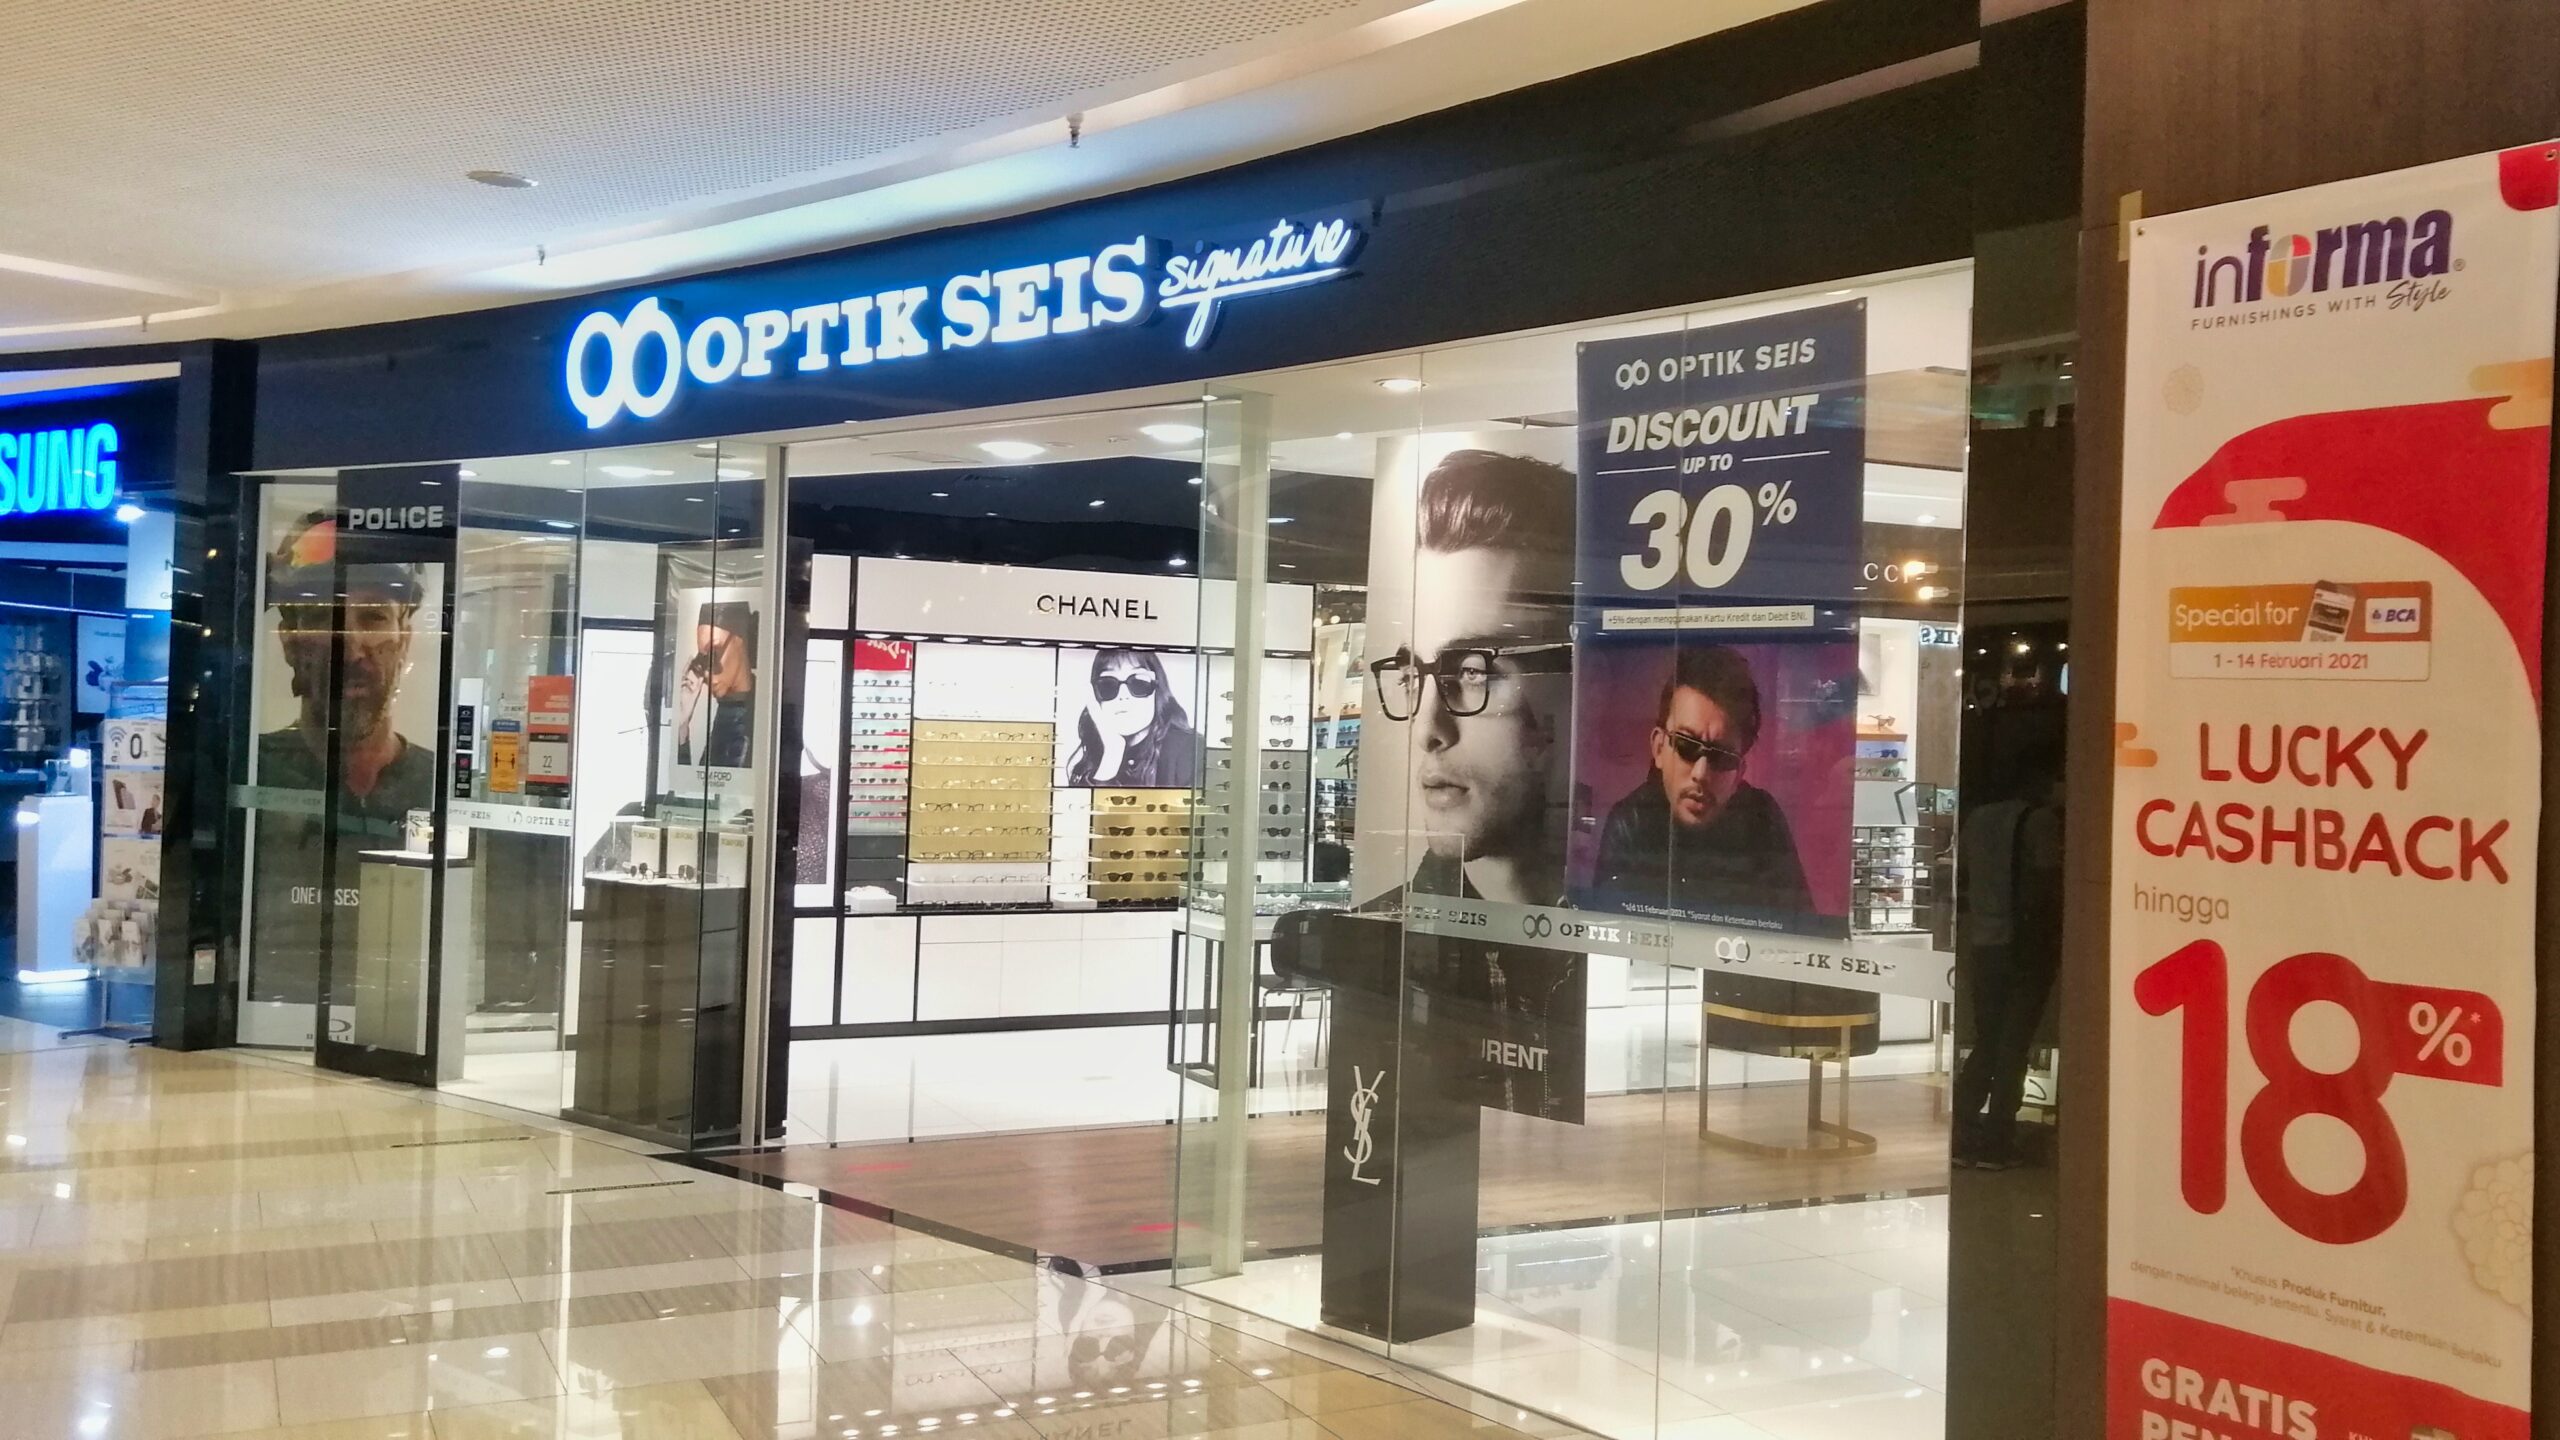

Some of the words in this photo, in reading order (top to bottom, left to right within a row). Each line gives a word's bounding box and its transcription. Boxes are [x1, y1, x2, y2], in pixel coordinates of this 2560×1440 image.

[2193, 209, 2452, 308] informa
[687, 285, 929, 384] OPTIK
[941, 235, 1146, 351] SEIS
[1158, 218, 1352, 348] signature
[2191, 304, 2316, 330] FURNISHINGS
[2328, 295, 2377, 313] WITH
[2386, 280, 2451, 312] Style
[1659, 349, 1744, 382] OPTIK
[1755, 338, 1816, 371] SEIS
[1606, 394, 1819, 453] DISCOUNT
[1682, 457, 1705, 474] UP
[1709, 453, 1733, 471] TO
[348, 505, 444, 530] POLICE
[1036, 594, 1158, 620] CHANEL
[1752, 611, 1766, 622] dan
[2175, 603, 2260, 631] Special
[2265, 602, 2299, 625] for
[2385, 608, 2416, 622] BCA
[2213, 654, 2221, 668] 1
[2238, 654, 2255, 668] 14
[2260, 654, 2322, 669] Februari
[2328, 653, 2368, 669] 2021
[2200, 722, 2428, 791] LUCKY
[2136, 799, 2509, 884] CASHBACK
[291, 887, 316, 904] ONE
[2134, 883, 2229, 924] hingga
[1560, 923, 1620, 943] OPTIK
[1626, 930, 1674, 948] SEIS
[2282, 1279, 2326, 1301] Produk
[2325, 1308, 2362, 1331] Syarat
[2366, 1321, 2376, 1334] &
[2141, 1358, 2317, 1440] GRATIS
